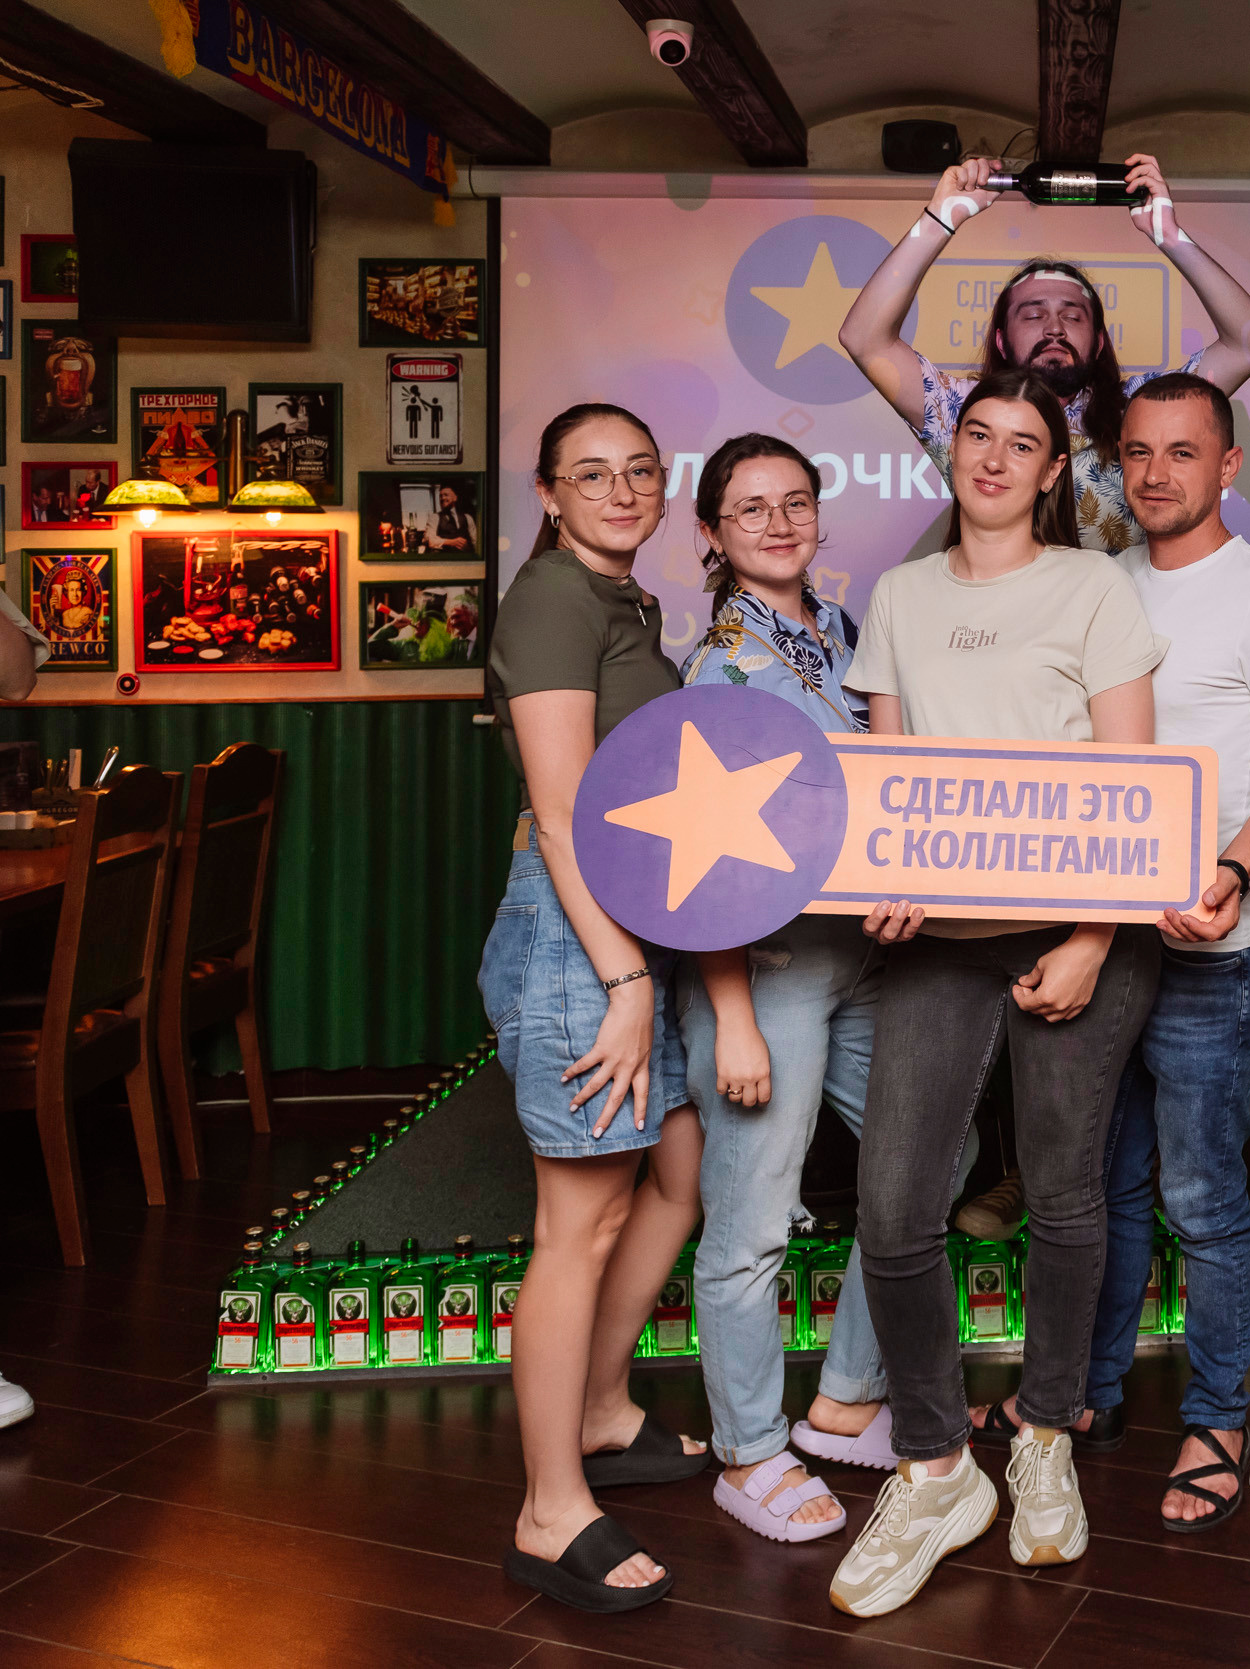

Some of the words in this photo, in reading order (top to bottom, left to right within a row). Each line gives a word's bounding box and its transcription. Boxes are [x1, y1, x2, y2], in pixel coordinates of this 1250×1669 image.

[227, 0, 410, 168] BARCELONA
[400, 364, 449, 376] WARNING
[140, 394, 217, 406] ТРЕХГОРНОЕ
[393, 444, 423, 455] NERVOUS
[424, 444, 457, 455] GUITARIST
[964, 629, 979, 637] the
[948, 629, 998, 652] light
[50, 643, 106, 656] REWCO
[880, 775, 1069, 823] СДЕЛАЛИ
[1079, 785, 1152, 824] ЭТО
[867, 828, 891, 867] С
[904, 830, 1159, 878] КОЛЛЕГАМИ!
